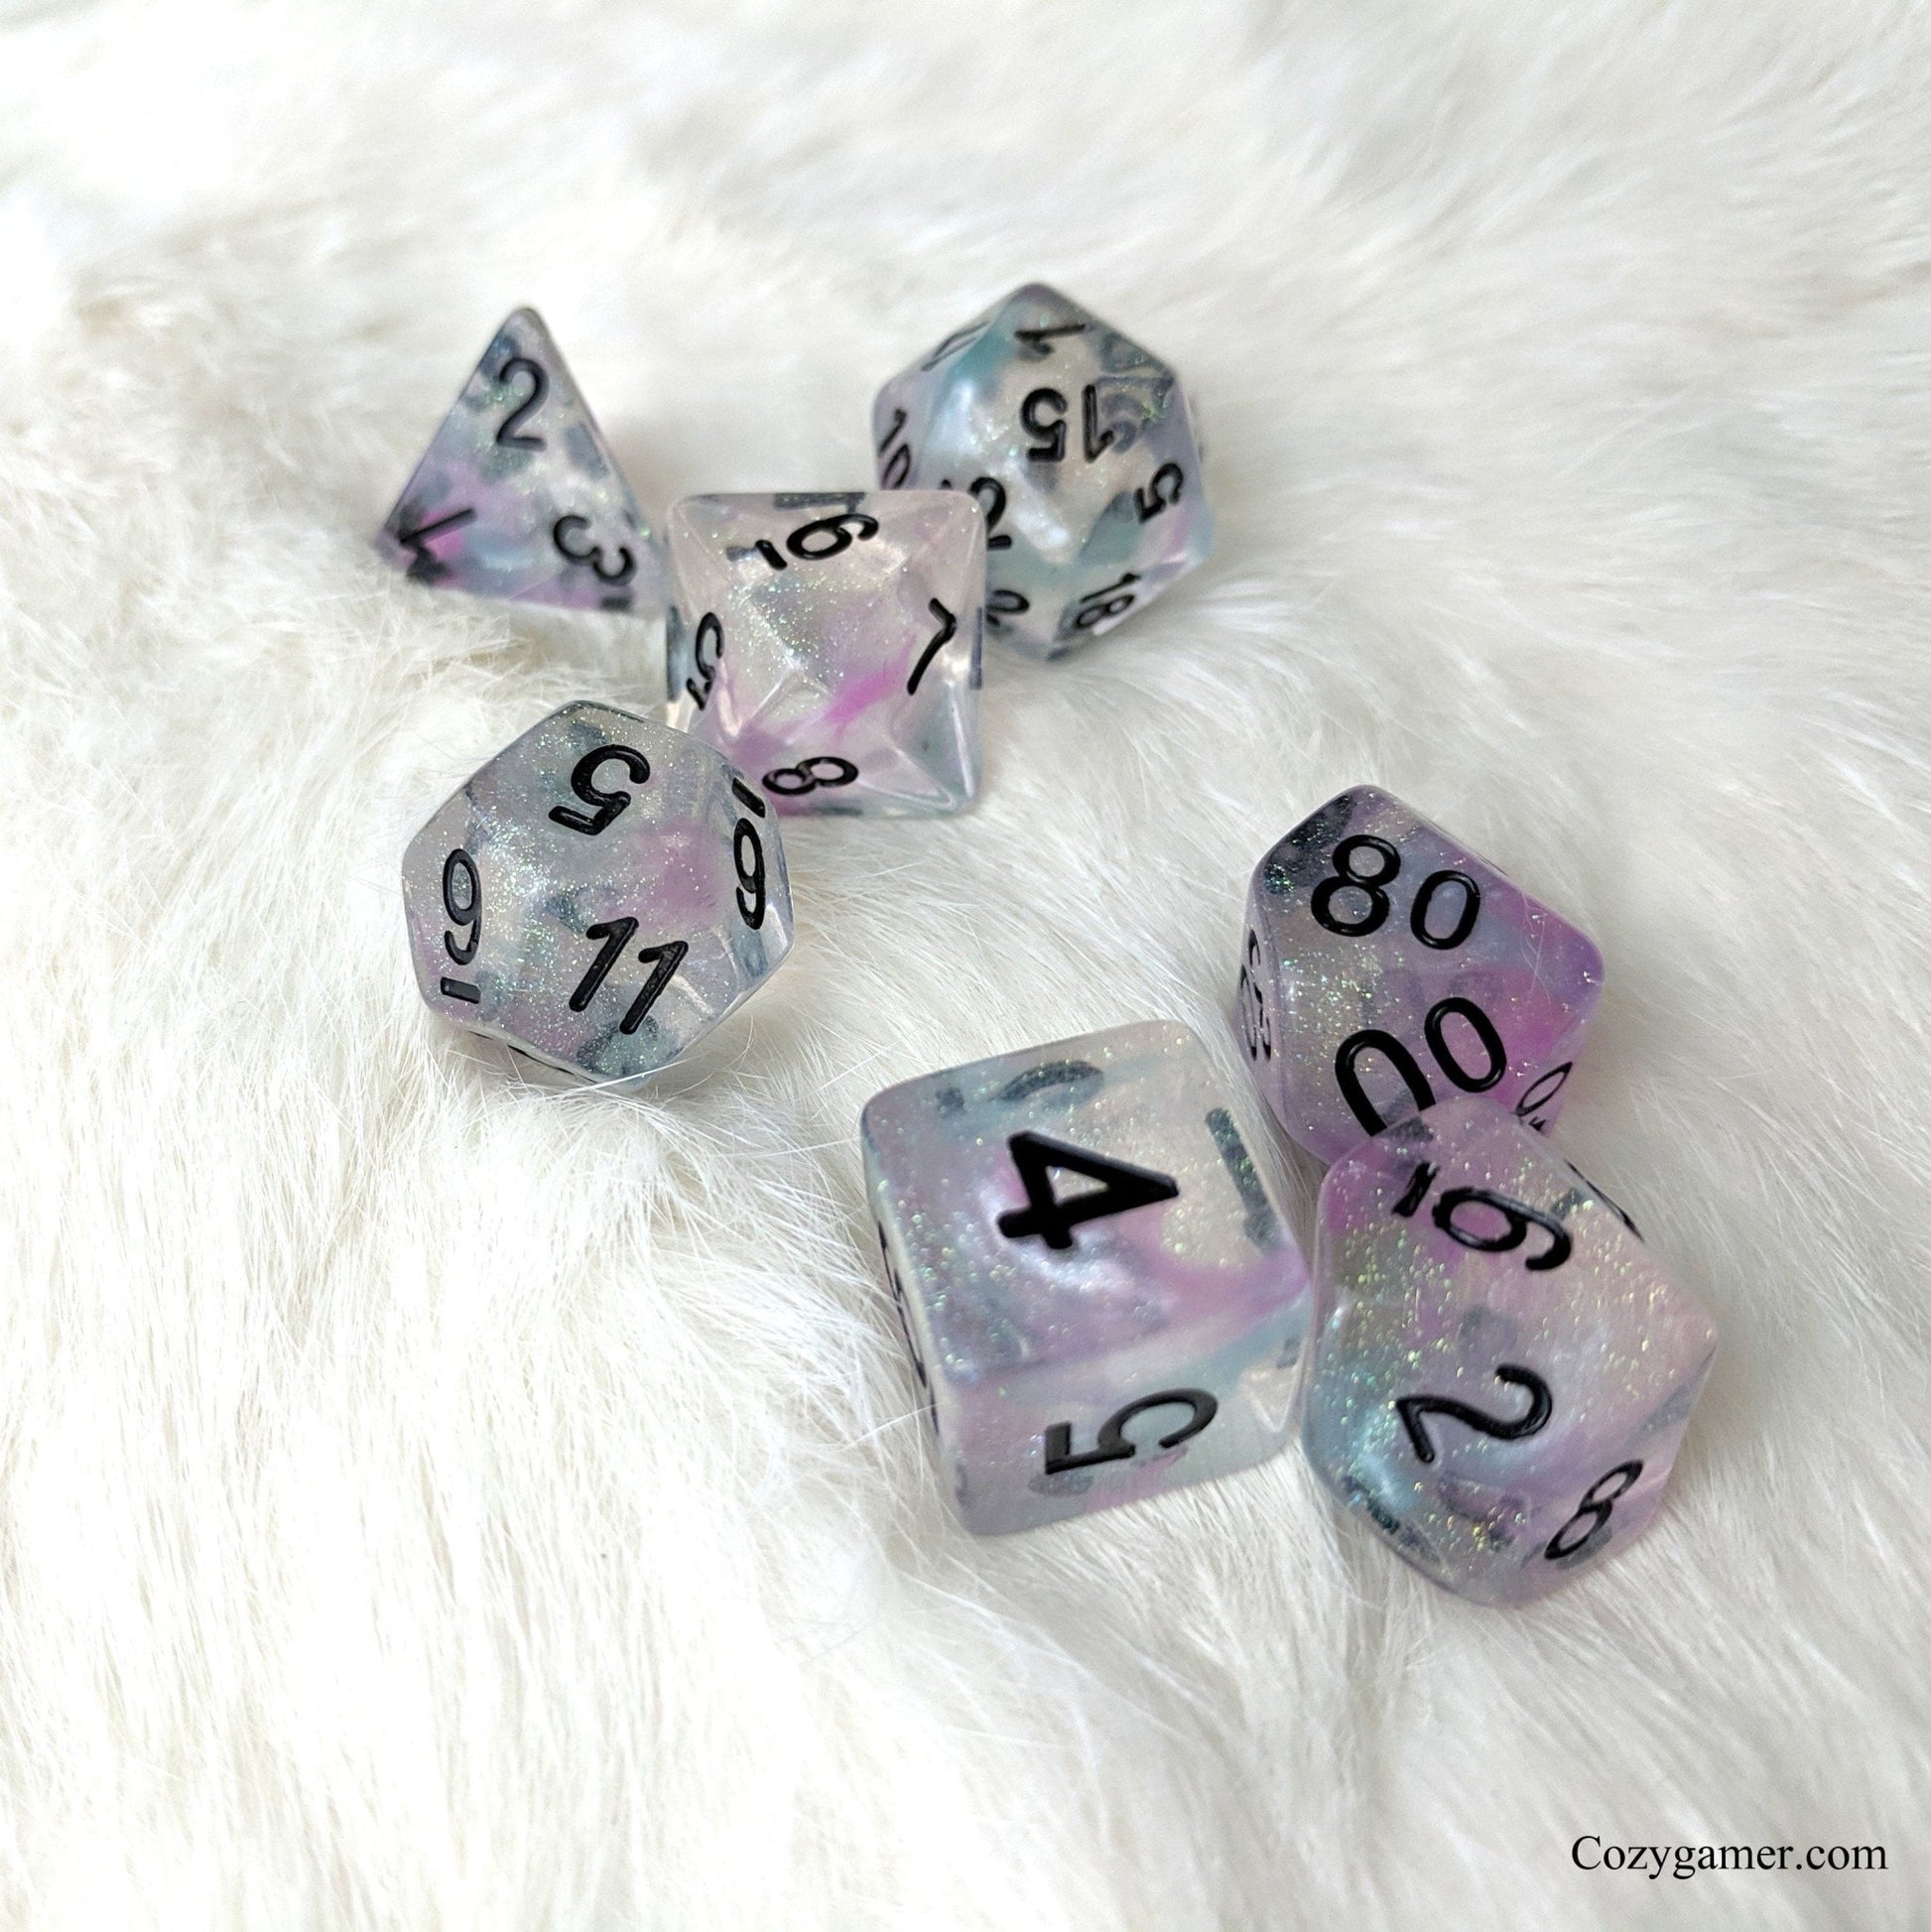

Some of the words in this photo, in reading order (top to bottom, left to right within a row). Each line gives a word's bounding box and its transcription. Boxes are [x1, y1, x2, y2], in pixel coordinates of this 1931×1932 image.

[495, 356, 550, 450] 2
[1020, 385, 1114, 463] 15
[1135, 462, 1185, 525] 5
[552, 514, 637, 585] 3
[905, 596, 958, 696] 7
[1075, 572, 1142, 629] 18
[548, 743, 651, 836] 5
[762, 755, 859, 797] 8
[1310, 834, 1481, 951] 80
[568, 915, 690, 1035] 11
[995, 1130, 1181, 1250] 4
[1045, 1388, 1219, 1476] 5
[1395, 1363, 1553, 1464] 2
[1544, 1460, 1643, 1561] 8
